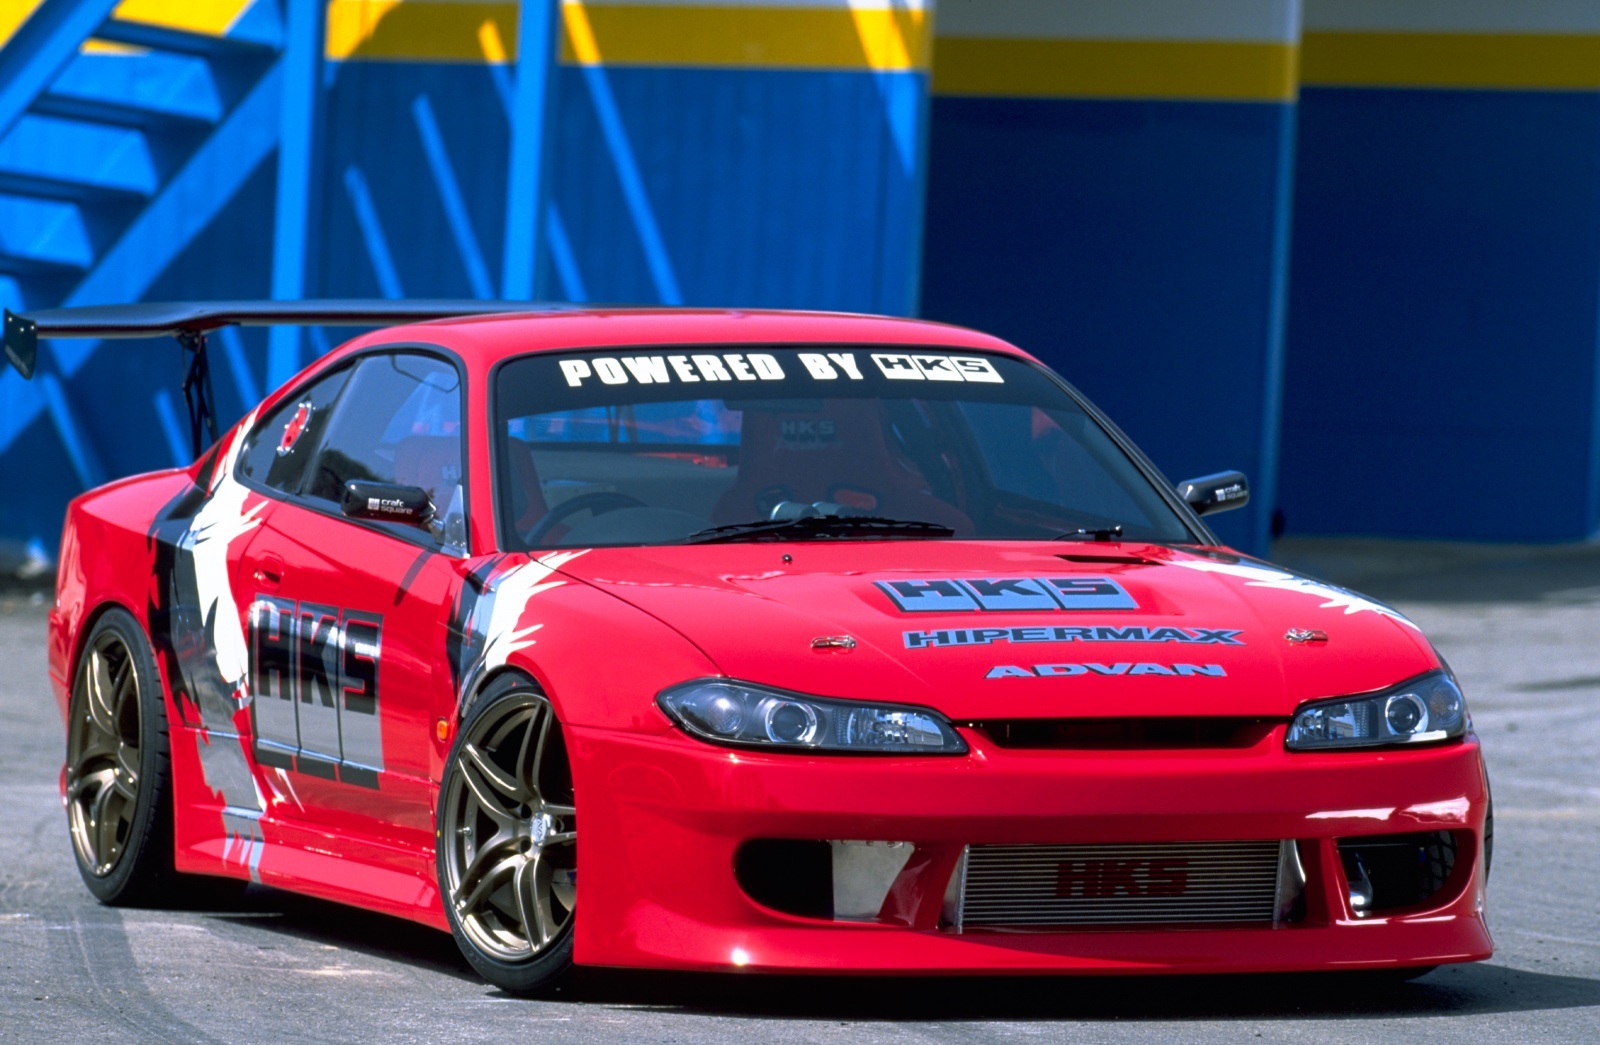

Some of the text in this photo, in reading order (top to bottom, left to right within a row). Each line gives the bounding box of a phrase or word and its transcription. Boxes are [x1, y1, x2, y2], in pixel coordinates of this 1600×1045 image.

[559, 353, 786, 387] POWERED
[797, 353, 864, 380] BY
[781, 420, 835, 435] HKS
[380, 505, 413, 515] square
[381, 499, 405, 508] craft
[902, 626, 1248, 648] HIPERMAX
[256, 606, 378, 716] HKS
[983, 663, 1227, 679] ADVAN
[1056, 861, 1190, 898] HKS
